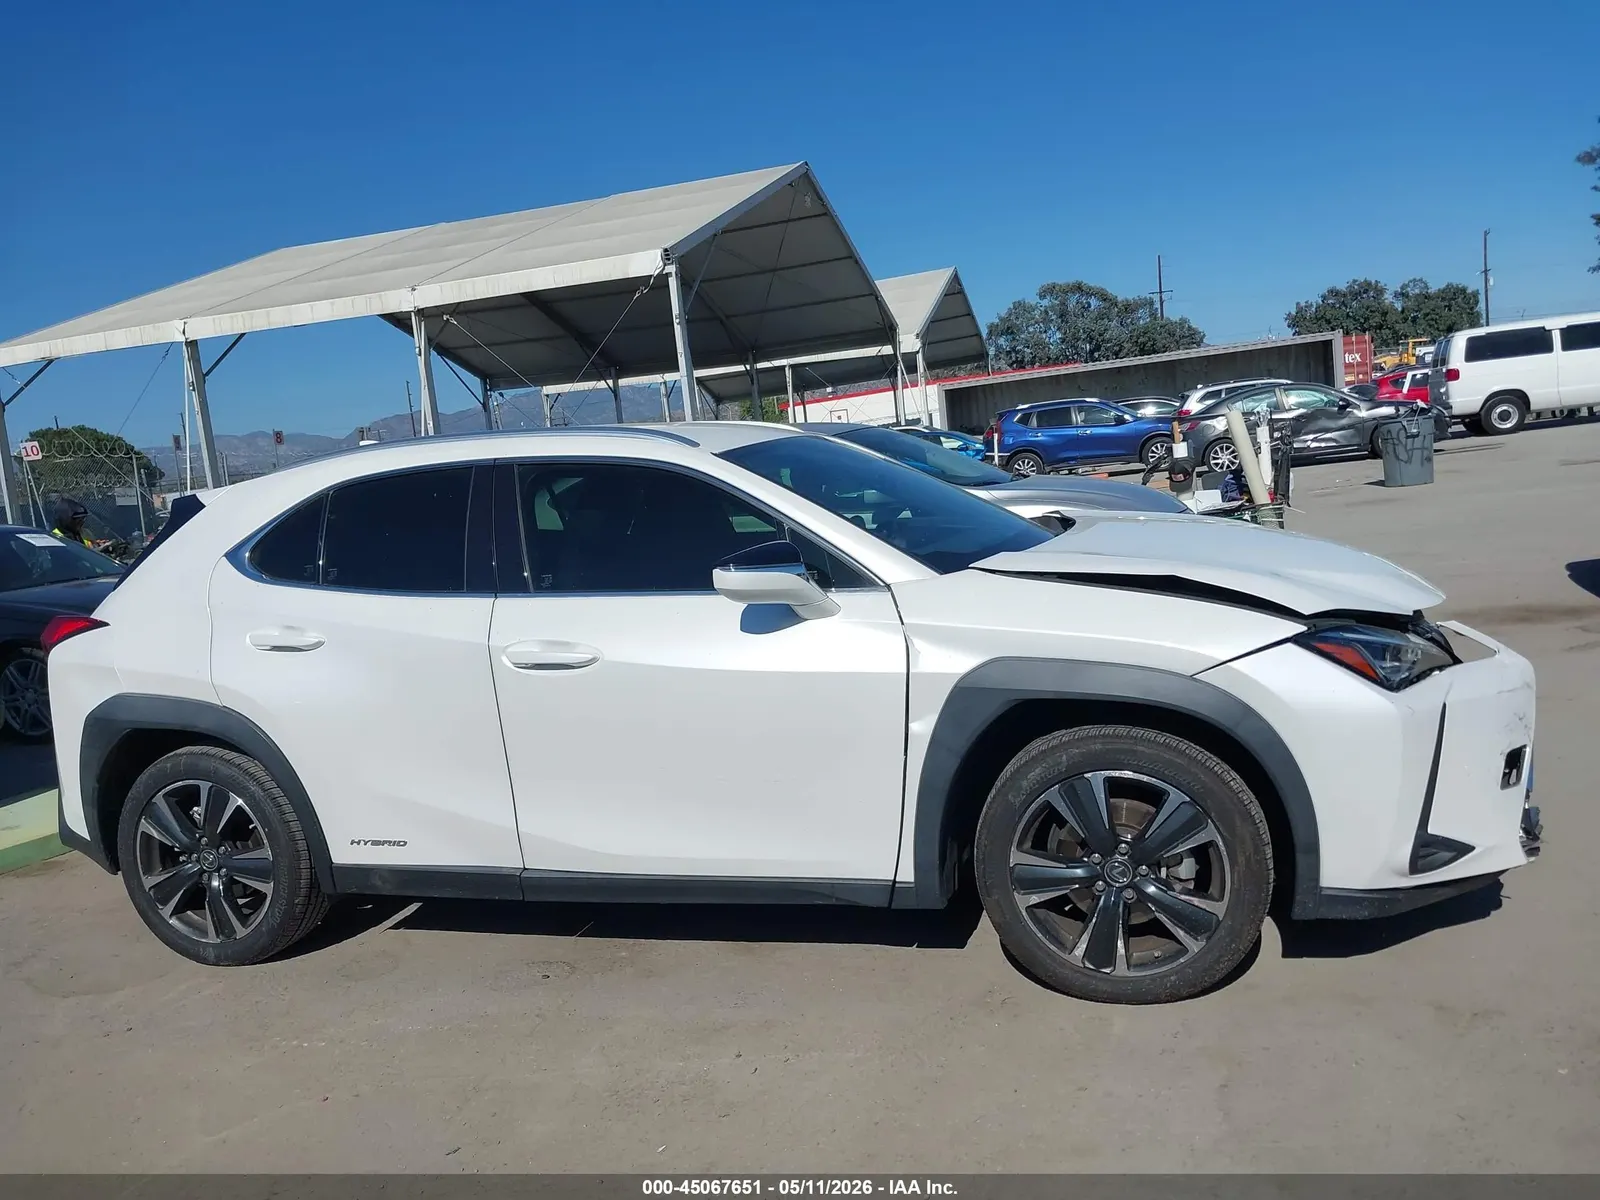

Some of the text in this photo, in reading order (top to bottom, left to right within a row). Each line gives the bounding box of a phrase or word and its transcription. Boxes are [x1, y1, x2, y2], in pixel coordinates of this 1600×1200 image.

[1344, 352, 1362, 363] tex
[275, 432, 282, 444] 8
[22, 445, 40, 457] 10
[350, 839, 408, 847] HYBRID
